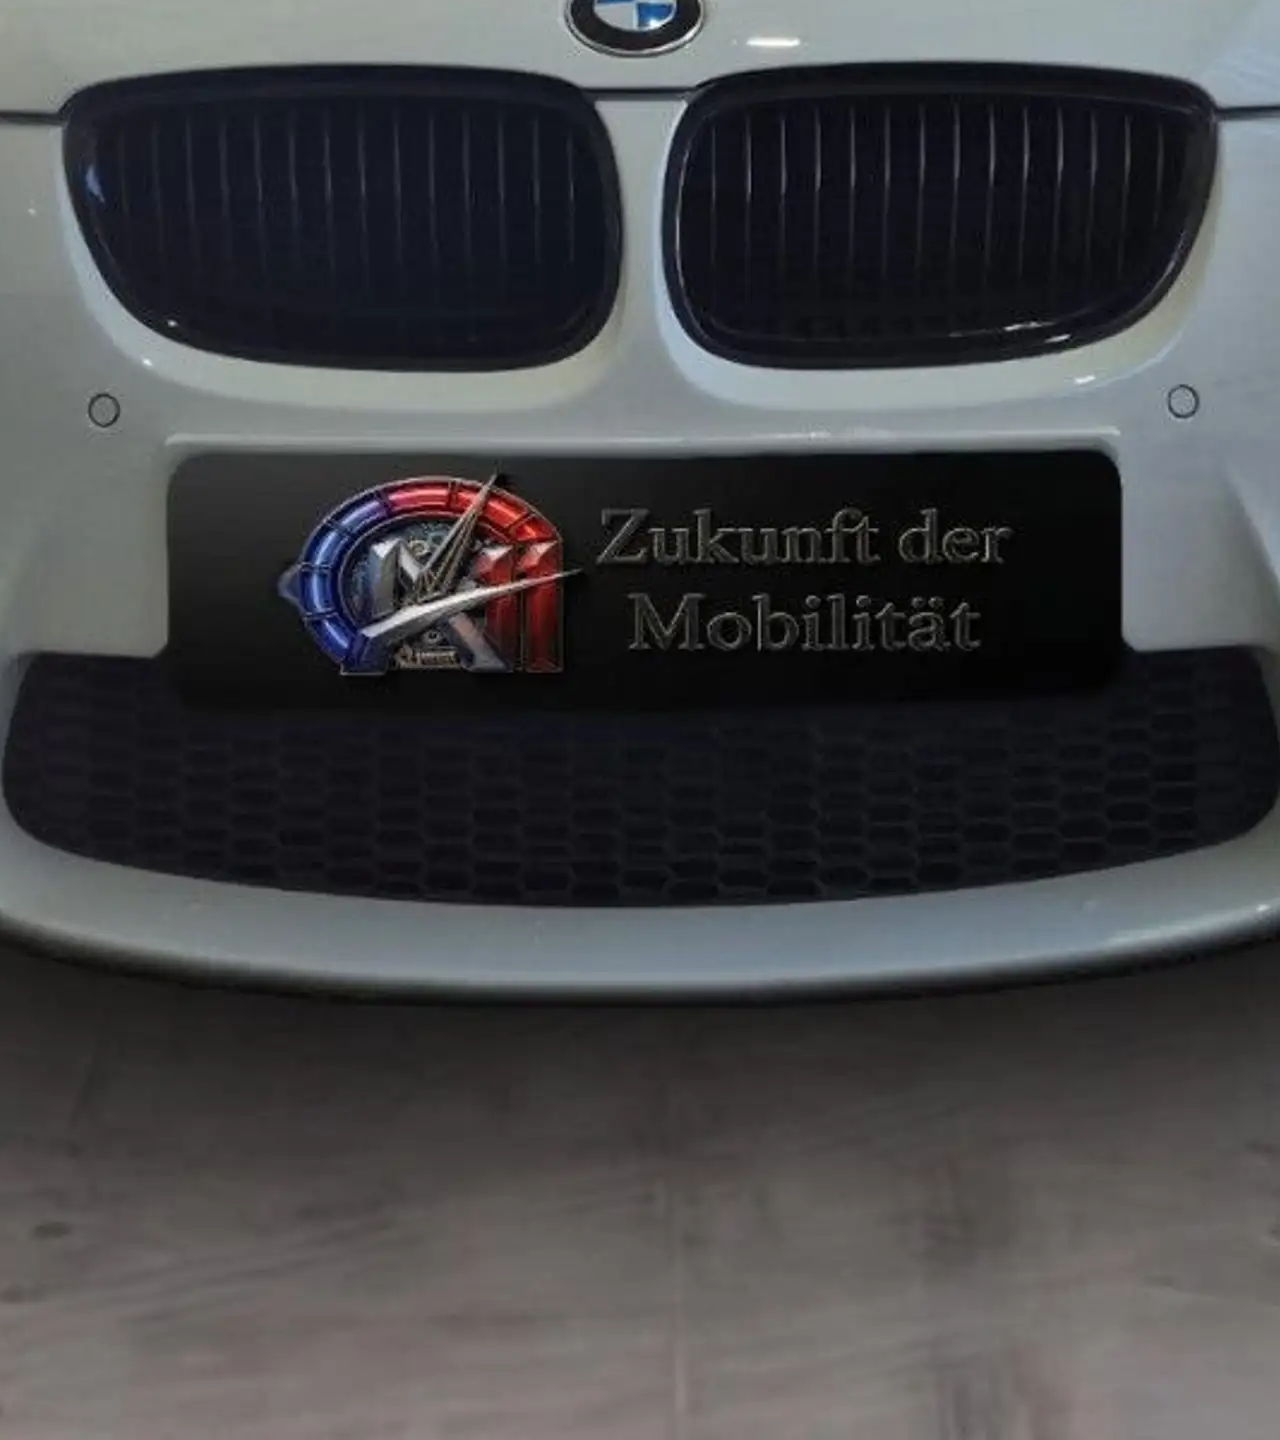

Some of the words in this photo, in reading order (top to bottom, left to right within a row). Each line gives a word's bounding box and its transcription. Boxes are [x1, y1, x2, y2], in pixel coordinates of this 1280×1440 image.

[596, 507, 882, 566] Zukunft
[898, 507, 1014, 566] der
[627, 592, 982, 652] Mobilität
